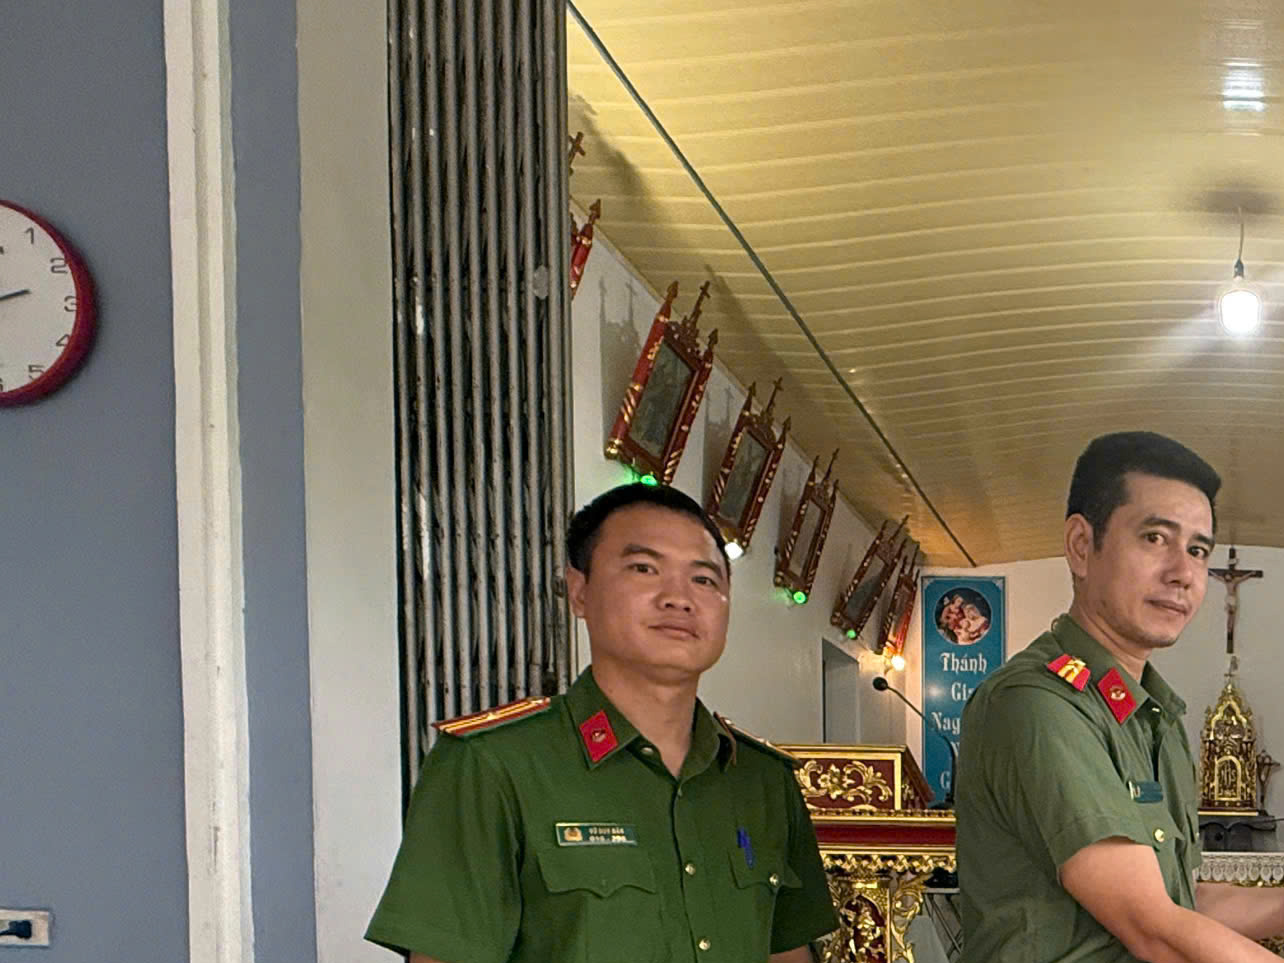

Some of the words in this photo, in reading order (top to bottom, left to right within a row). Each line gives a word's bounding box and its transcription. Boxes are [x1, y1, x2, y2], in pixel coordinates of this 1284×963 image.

[25, 226, 36, 245] 1
[50, 257, 69, 274] 2
[63, 295, 77, 313] 3
[940, 652, 988, 675] Thánh
